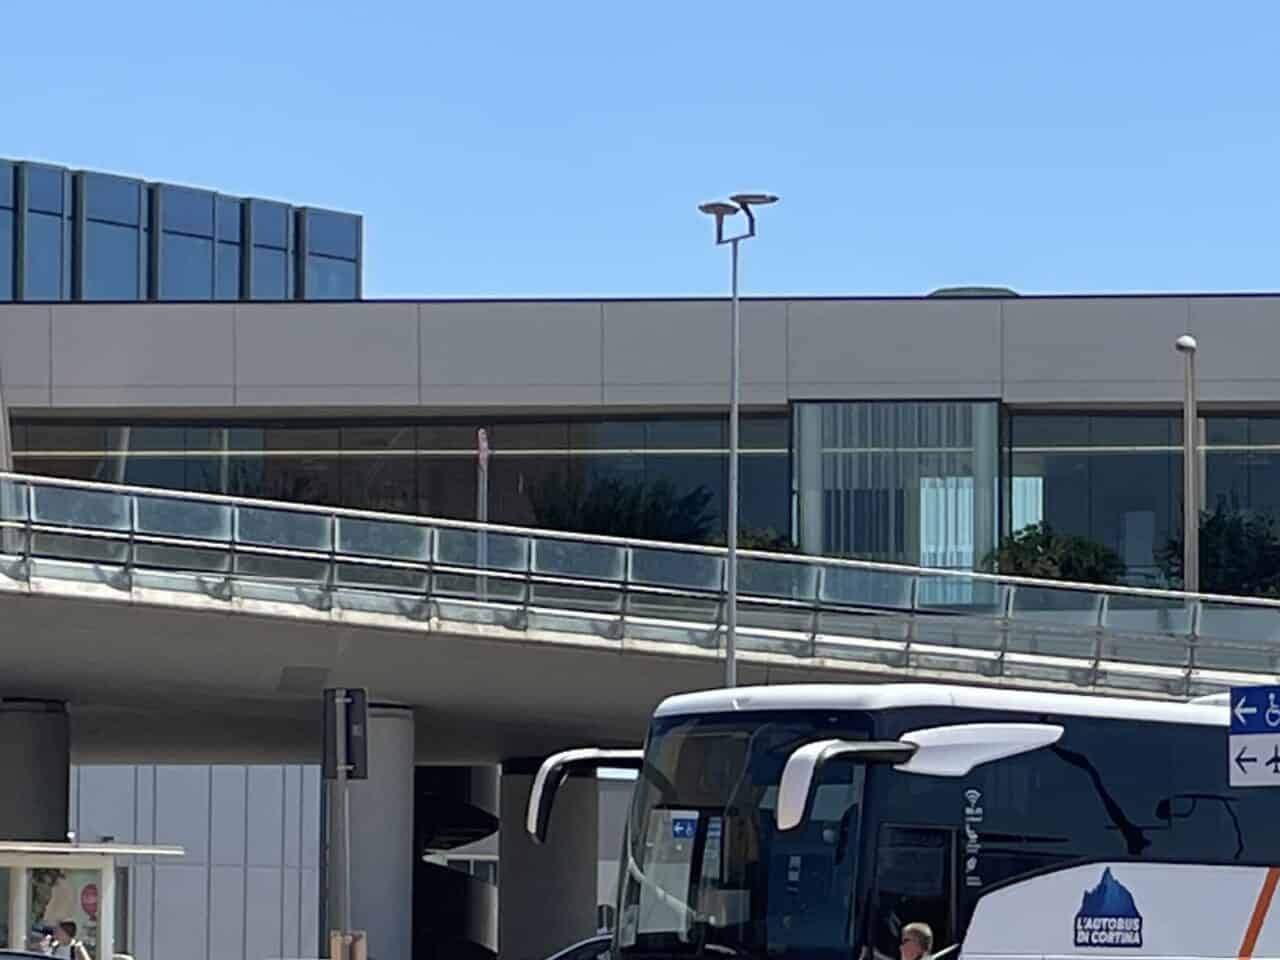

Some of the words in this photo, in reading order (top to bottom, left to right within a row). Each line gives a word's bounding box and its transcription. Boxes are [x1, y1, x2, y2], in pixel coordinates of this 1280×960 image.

[1077, 917, 1140, 930] L'AUTOBUS
[1077, 931, 1090, 944] DI
[1091, 931, 1140, 944] CORTINA
